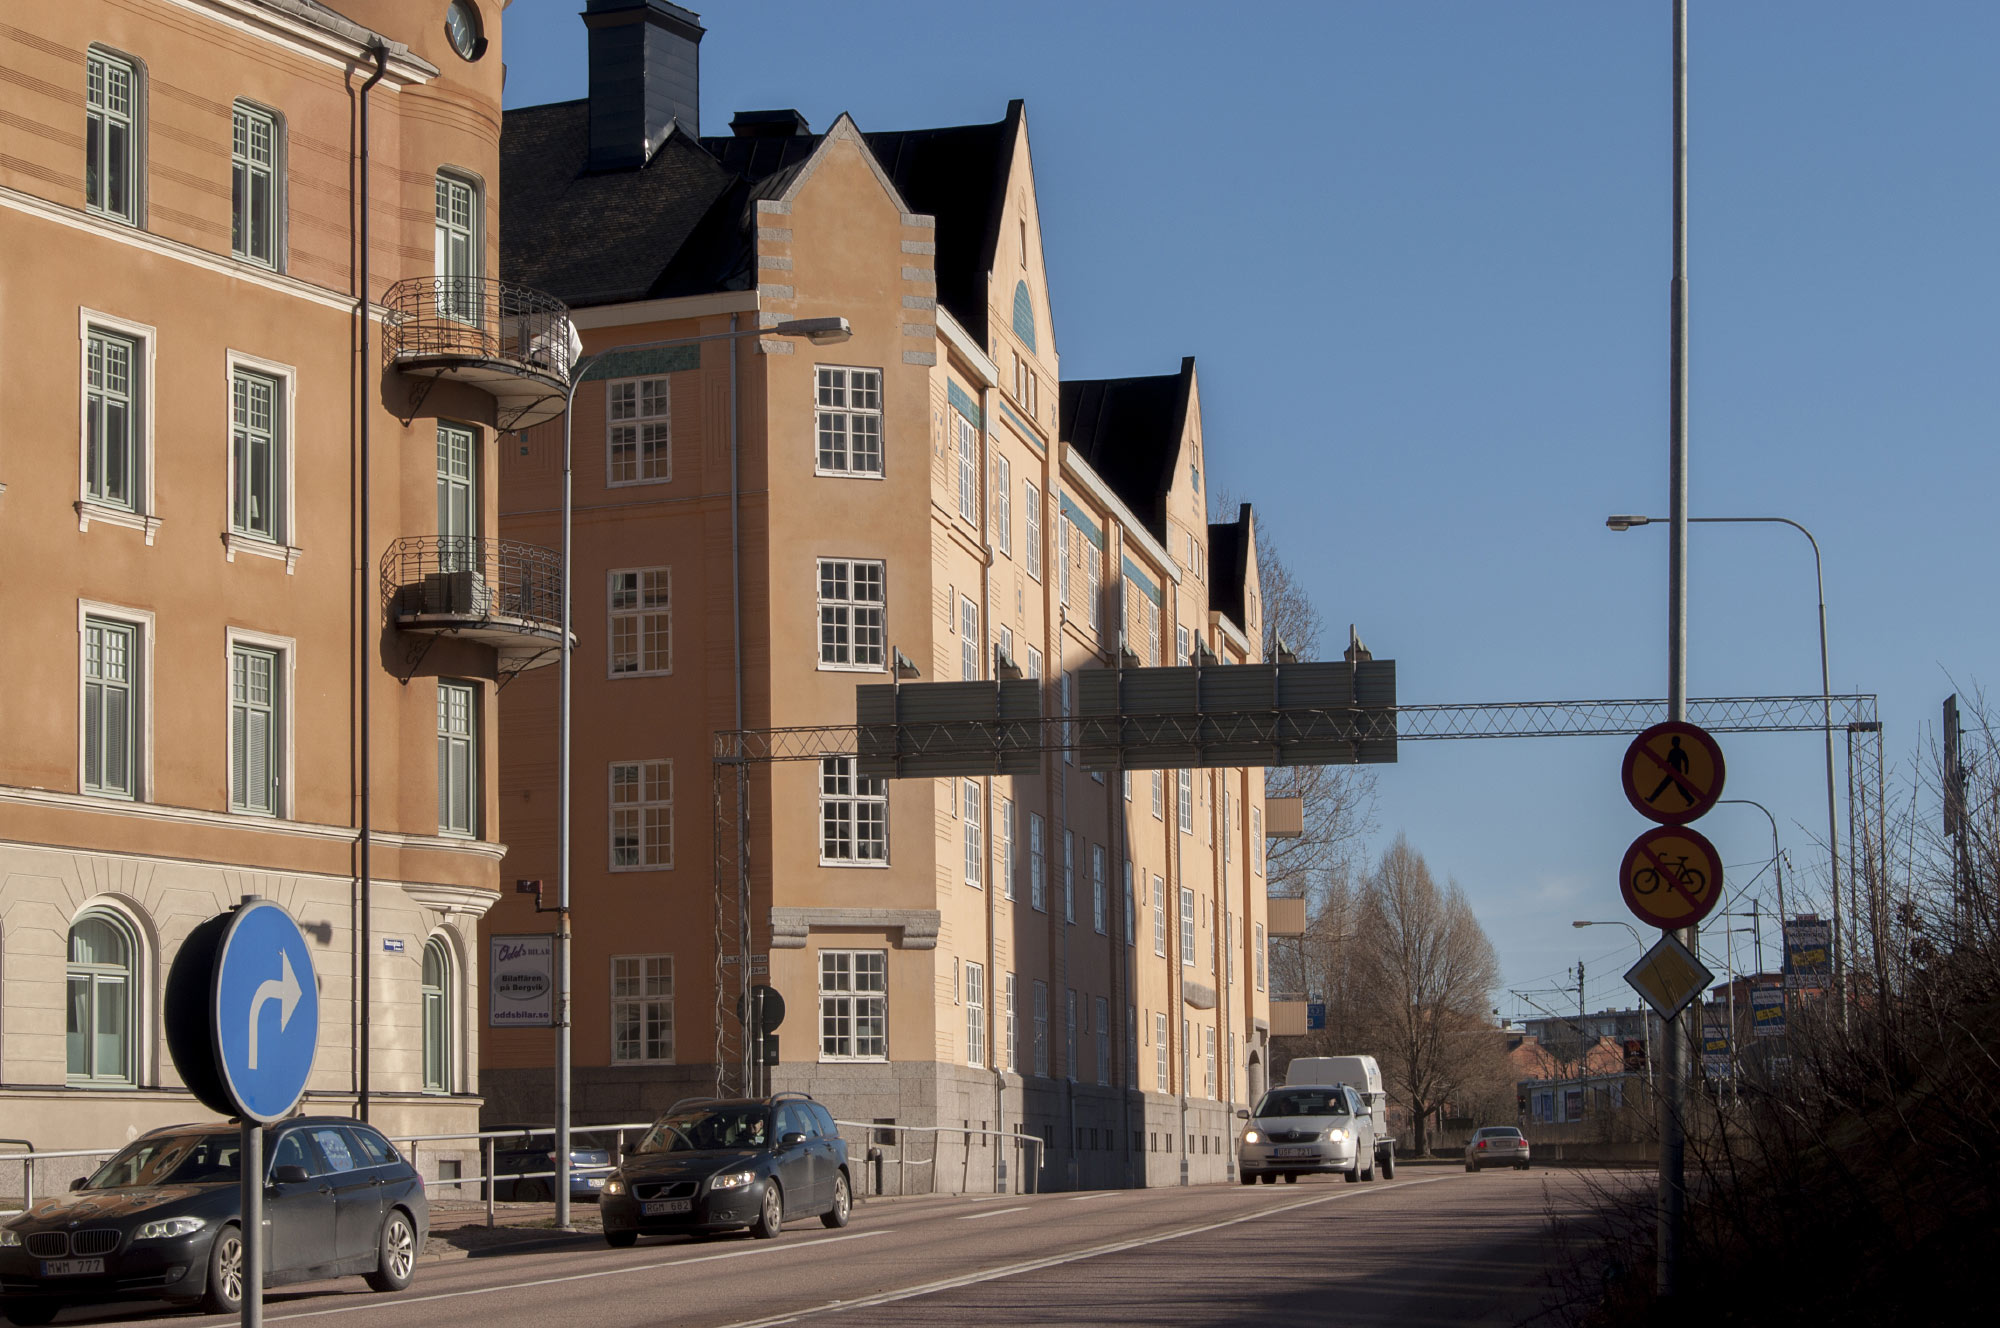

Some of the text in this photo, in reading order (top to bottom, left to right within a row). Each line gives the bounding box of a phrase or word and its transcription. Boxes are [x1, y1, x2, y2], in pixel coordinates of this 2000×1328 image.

[528, 948, 550, 956] BILAR
[500, 984, 543, 992] på Bergvik
[495, 1011, 549, 1019] oddsbilar.se
[646, 1201, 689, 1212] RGM 682
[47, 1260, 100, 1274] MWM 777
